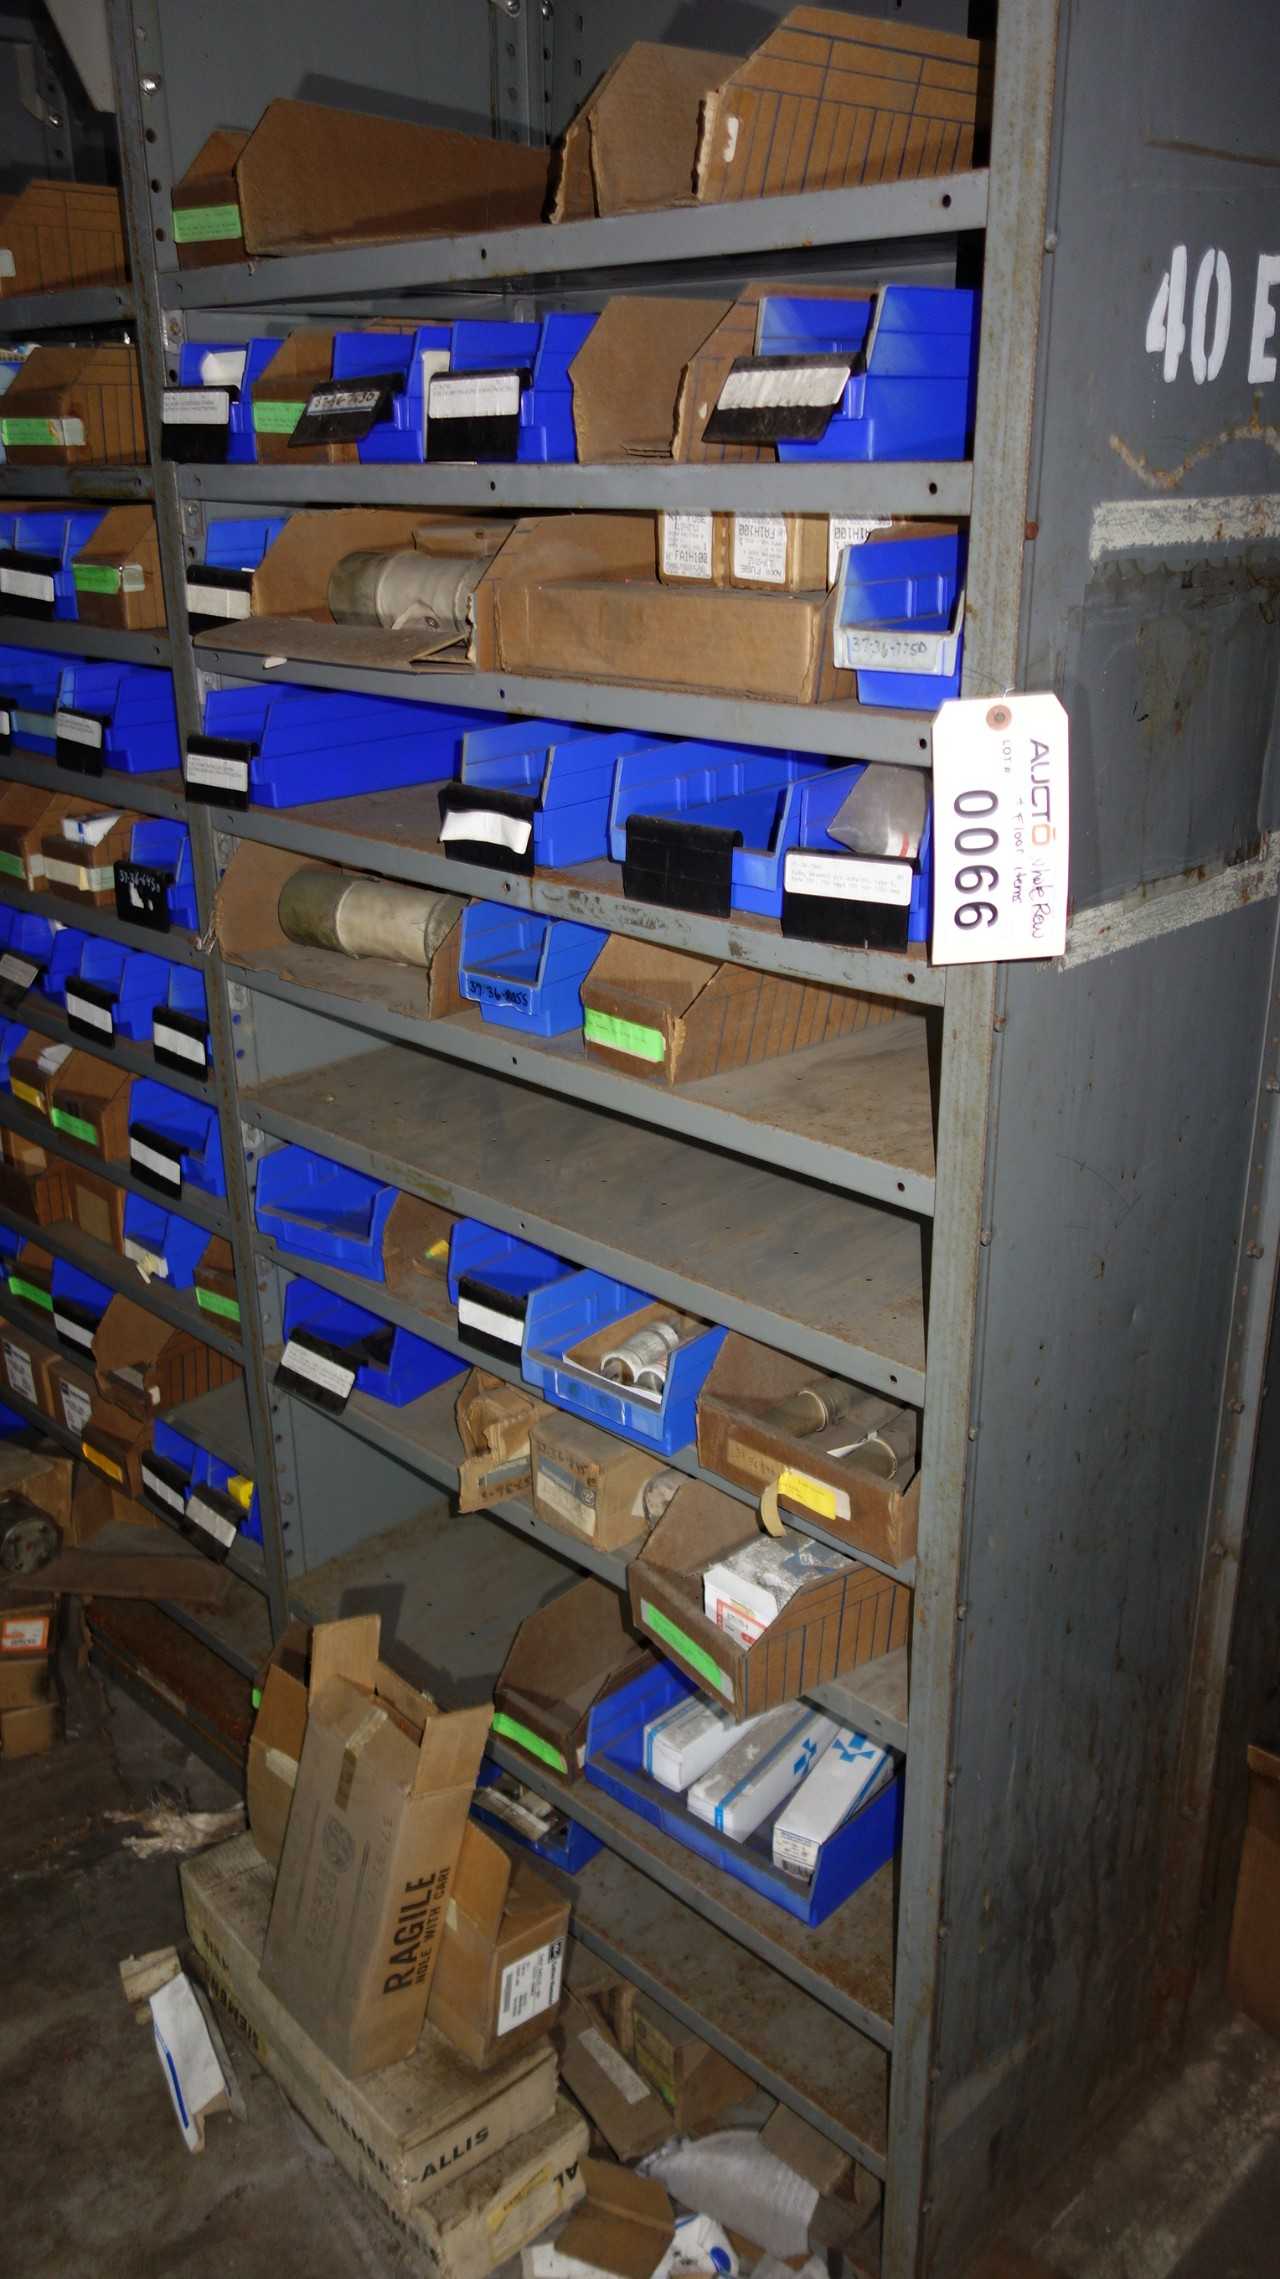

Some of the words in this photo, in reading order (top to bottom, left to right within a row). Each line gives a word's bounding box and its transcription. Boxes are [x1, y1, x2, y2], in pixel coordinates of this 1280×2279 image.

[1145, 244, 1231, 385] 40
[1003, 739, 1012, 761] LOT
[954, 789, 1000, 931] 0066
[383, 1871, 437, 1994] RAGILE
